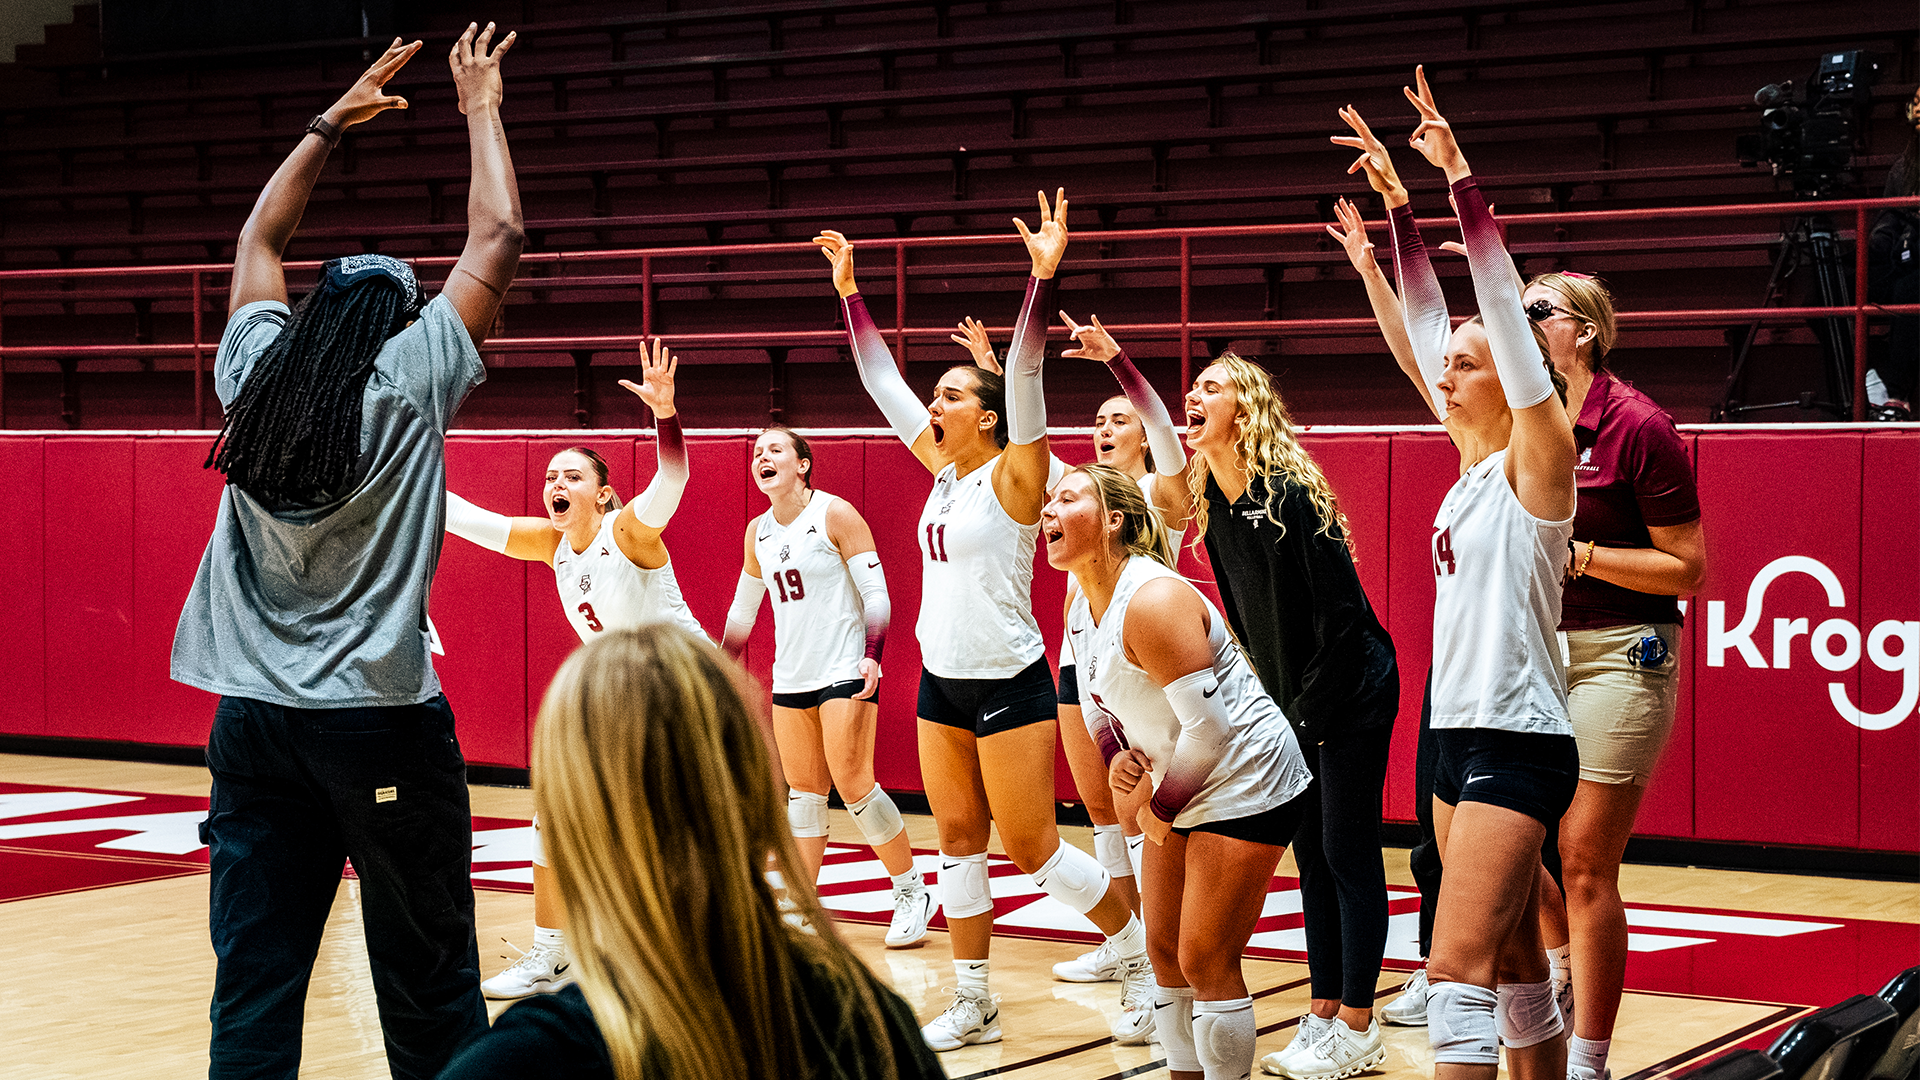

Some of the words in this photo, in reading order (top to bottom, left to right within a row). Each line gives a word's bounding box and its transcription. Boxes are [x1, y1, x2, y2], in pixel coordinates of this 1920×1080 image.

[926, 523, 948, 562] 11
[773, 568, 806, 603] 19
[578, 602, 604, 632] 3
